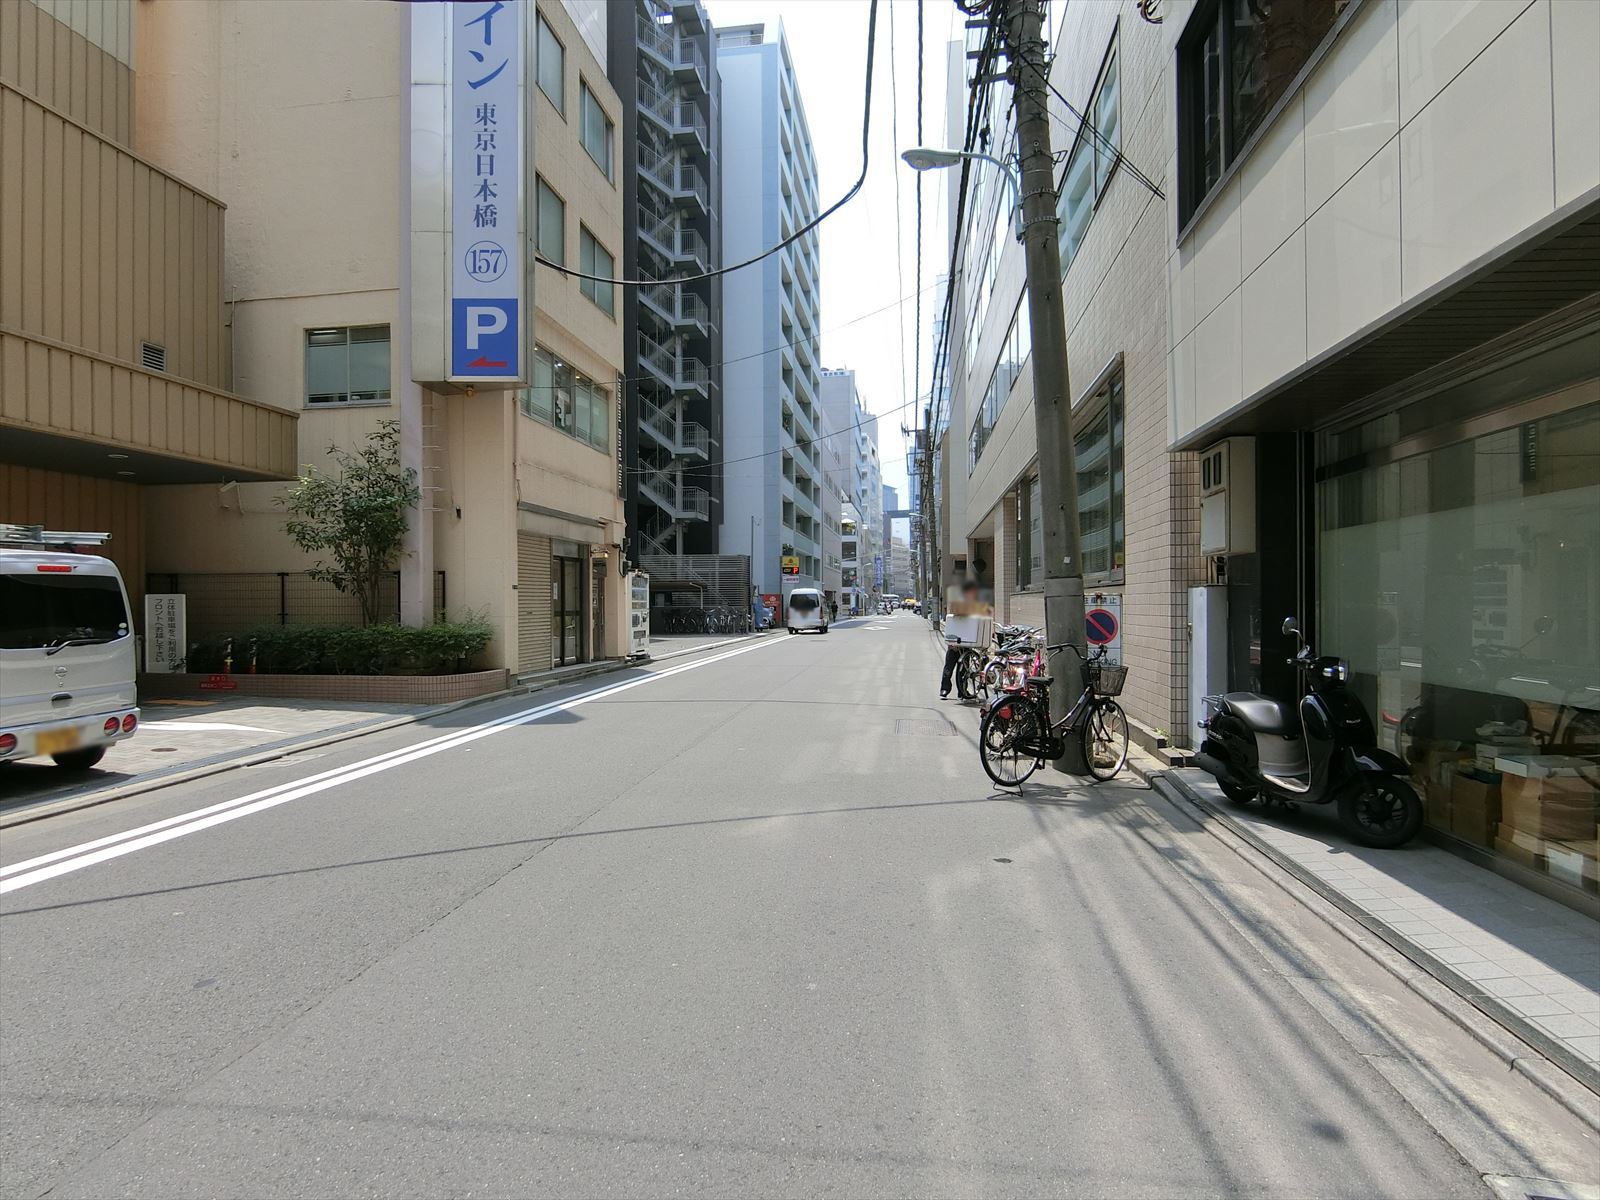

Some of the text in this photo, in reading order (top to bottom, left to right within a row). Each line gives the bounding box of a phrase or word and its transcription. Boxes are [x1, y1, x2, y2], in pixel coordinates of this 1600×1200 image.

[464, 2, 509, 227] イン 東京日本橋
[469, 251, 503, 275] 157
[466, 307, 509, 350] P
